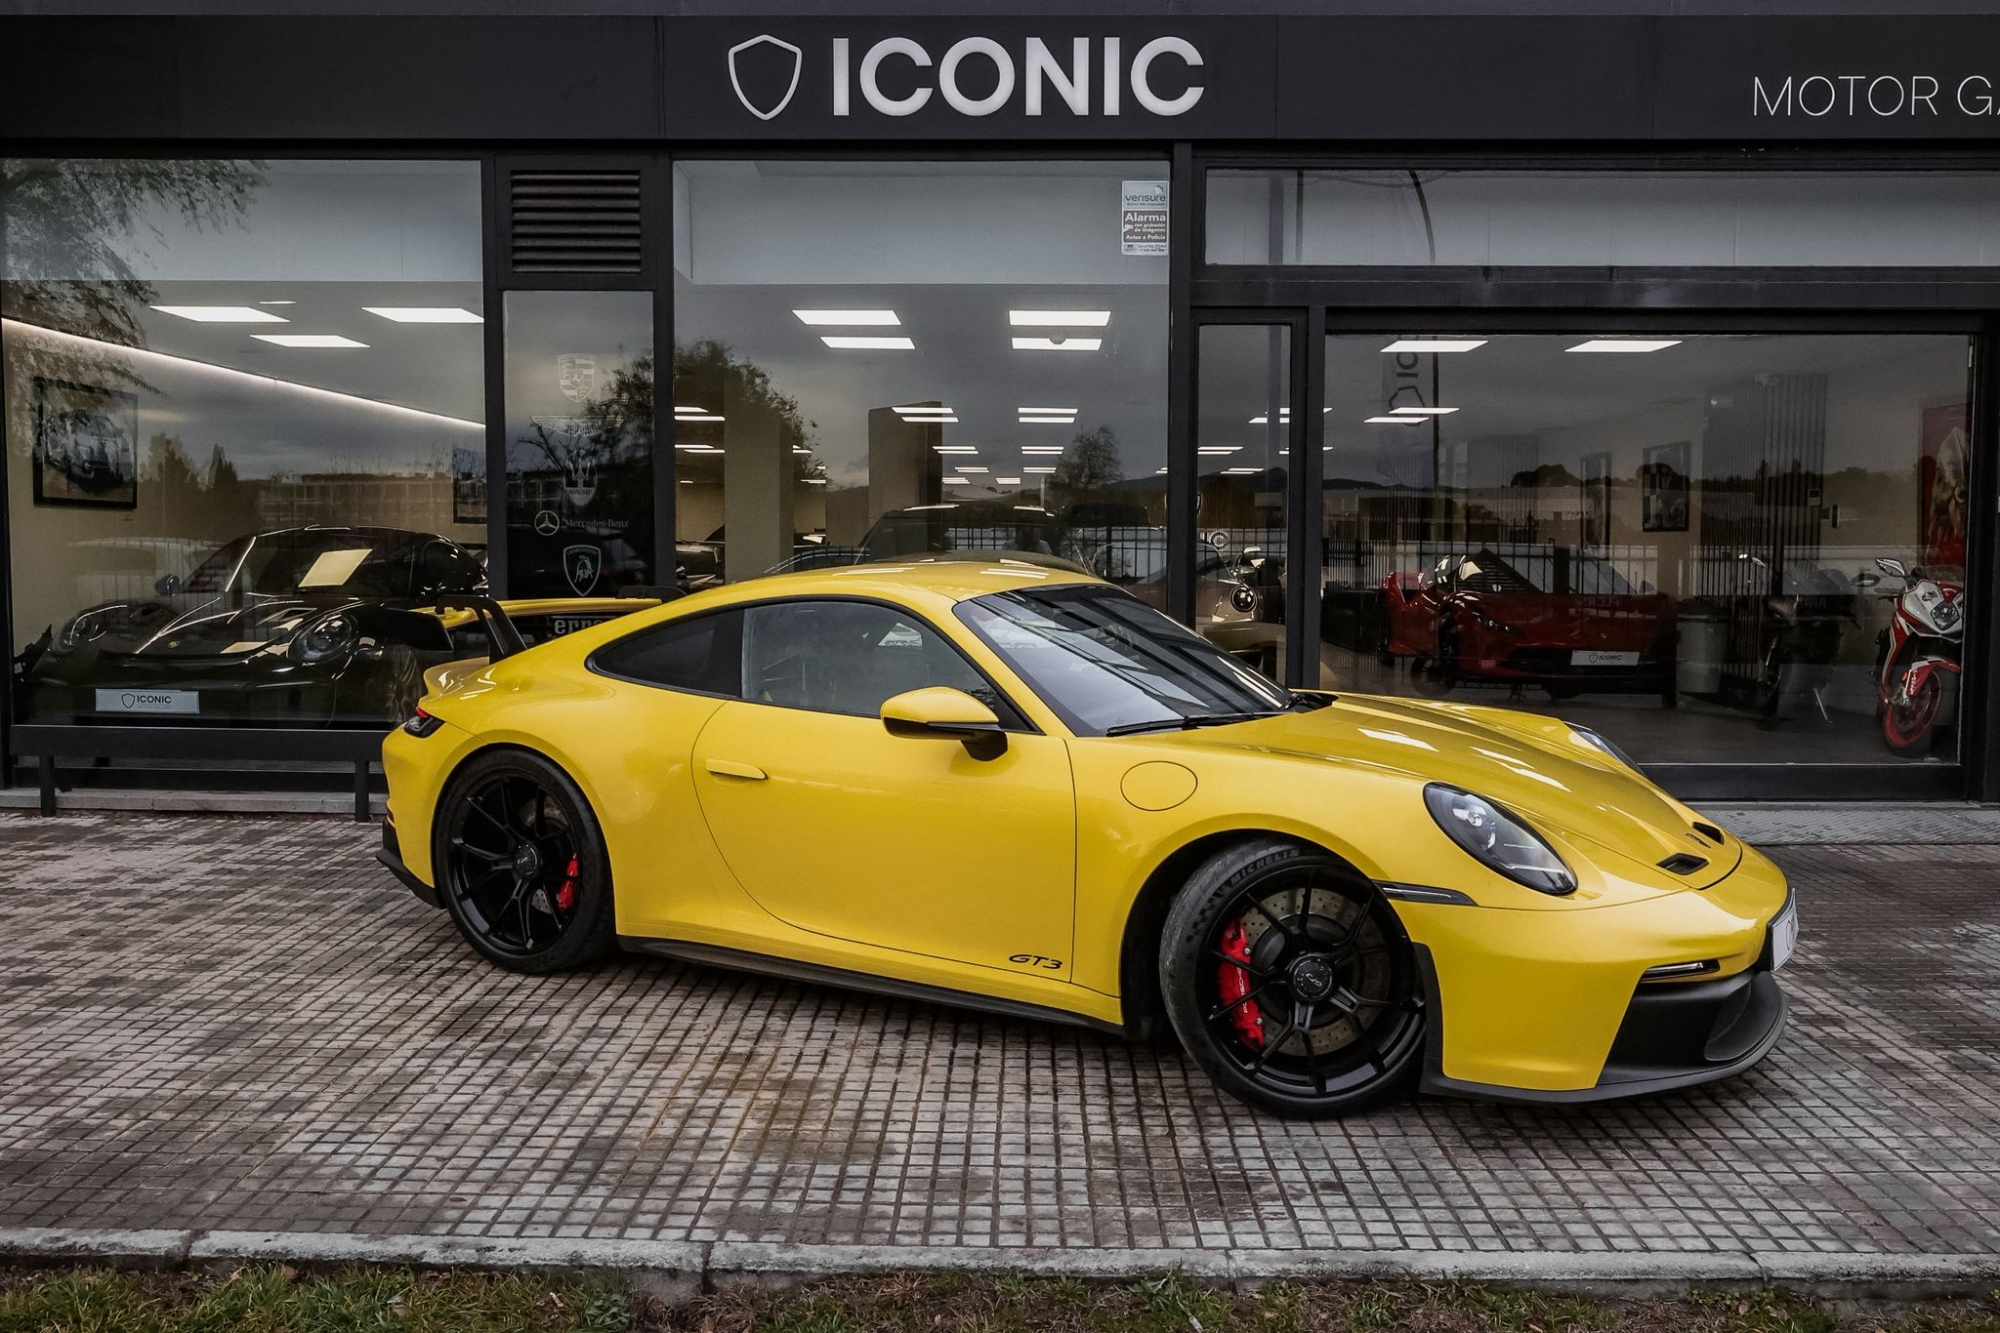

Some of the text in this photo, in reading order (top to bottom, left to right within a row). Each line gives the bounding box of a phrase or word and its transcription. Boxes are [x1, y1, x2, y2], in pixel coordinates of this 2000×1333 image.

[832, 36, 1204, 116] ICONIC
[1753, 75, 2000, 117] MOTOR G
[1125, 194, 1166, 202] verisure
[1125, 212, 1166, 222] Alarma
[137, 695, 172, 704] ICONIC
[1230, 849, 1299, 886] MICHELIN
[1008, 954, 1063, 970] GT3
